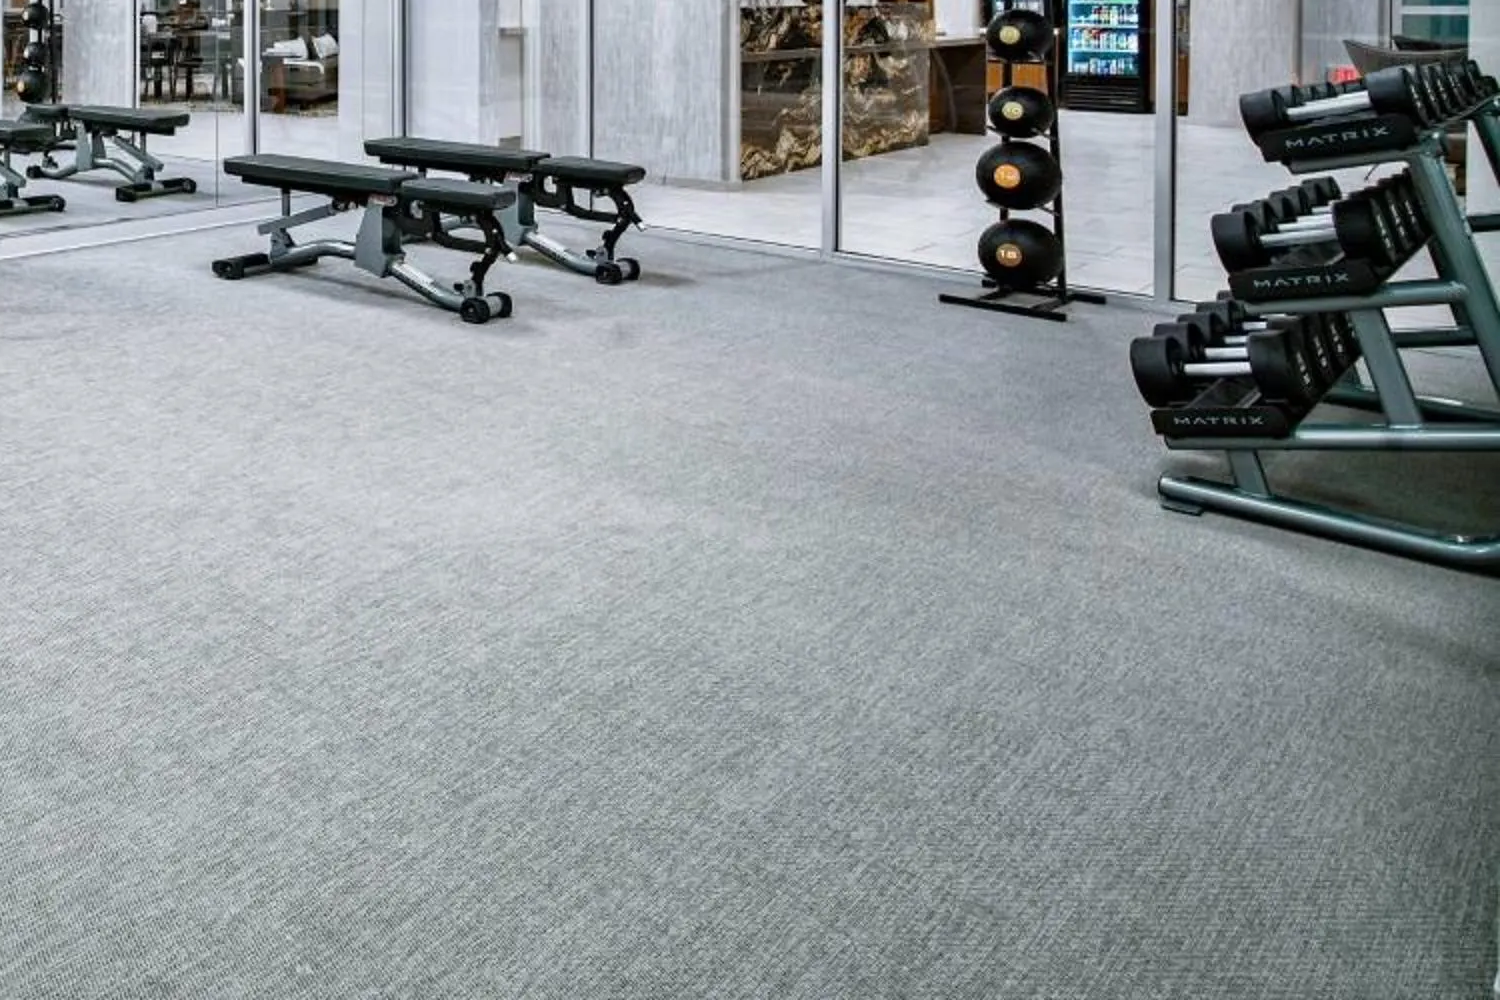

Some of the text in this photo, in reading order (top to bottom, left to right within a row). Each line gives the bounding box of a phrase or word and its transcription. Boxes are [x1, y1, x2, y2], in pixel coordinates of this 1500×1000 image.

[1285, 126, 1389, 149] MATRIX
[1253, 273, 1349, 289] MATRIX
[1173, 415, 1265, 426] MATRIX
